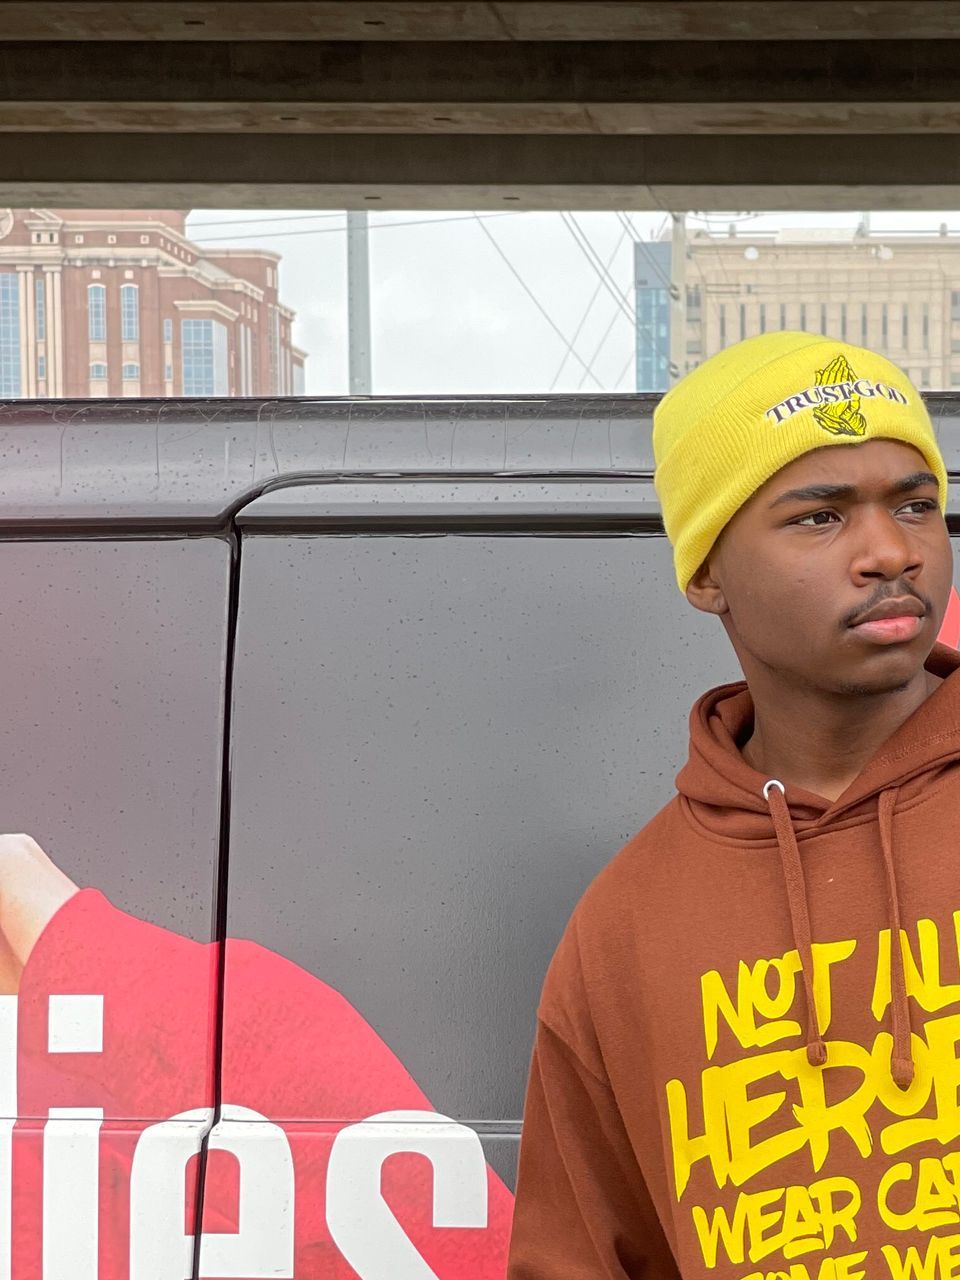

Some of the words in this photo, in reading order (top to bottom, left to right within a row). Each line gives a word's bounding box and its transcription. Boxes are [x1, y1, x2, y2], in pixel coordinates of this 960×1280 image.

[765, 382, 851, 424] TRUST
[853, 379, 908, 406] GOD
[700, 939, 857, 1060] NOT
[692, 1176, 862, 1269] WEAR
